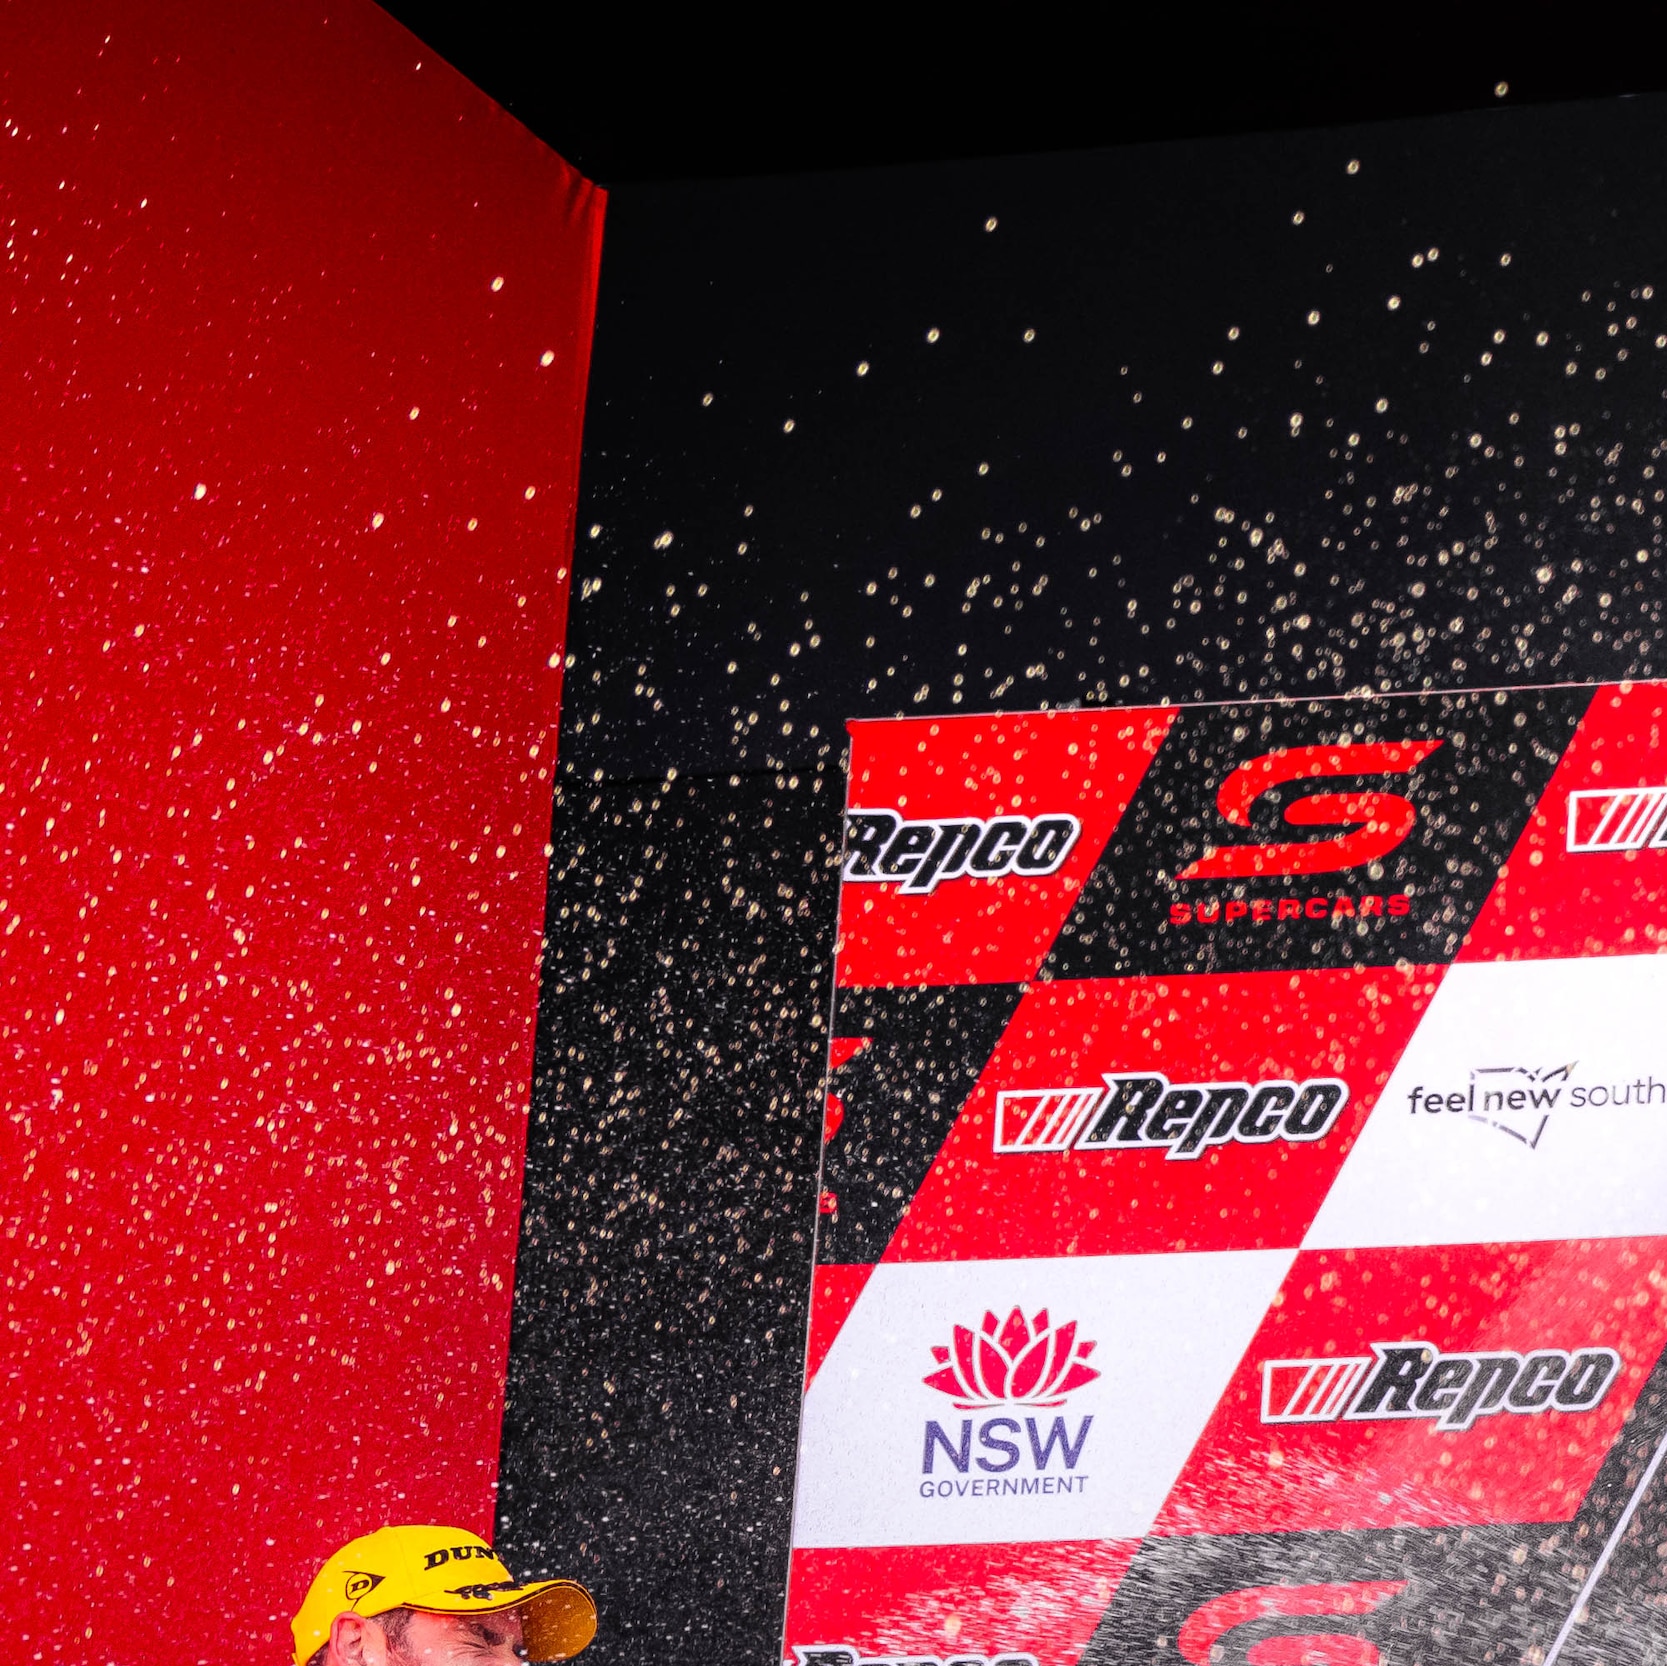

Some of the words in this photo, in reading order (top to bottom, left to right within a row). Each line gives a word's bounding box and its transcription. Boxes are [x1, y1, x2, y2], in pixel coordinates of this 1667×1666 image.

[845, 811, 1083, 894] Repco
[1168, 893, 1411, 926] SUPERCARS
[1076, 1072, 1349, 1161] Repco
[1407, 1080, 1476, 1116] feel
[1483, 1080, 1558, 1112] new
[1569, 1076, 1667, 1108] south
[1342, 1341, 1621, 1431] Repco
[923, 1414, 1093, 1476] NSW
[918, 1473, 1090, 1500] GOVERNMENT
[424, 1545, 497, 1571] DUN
